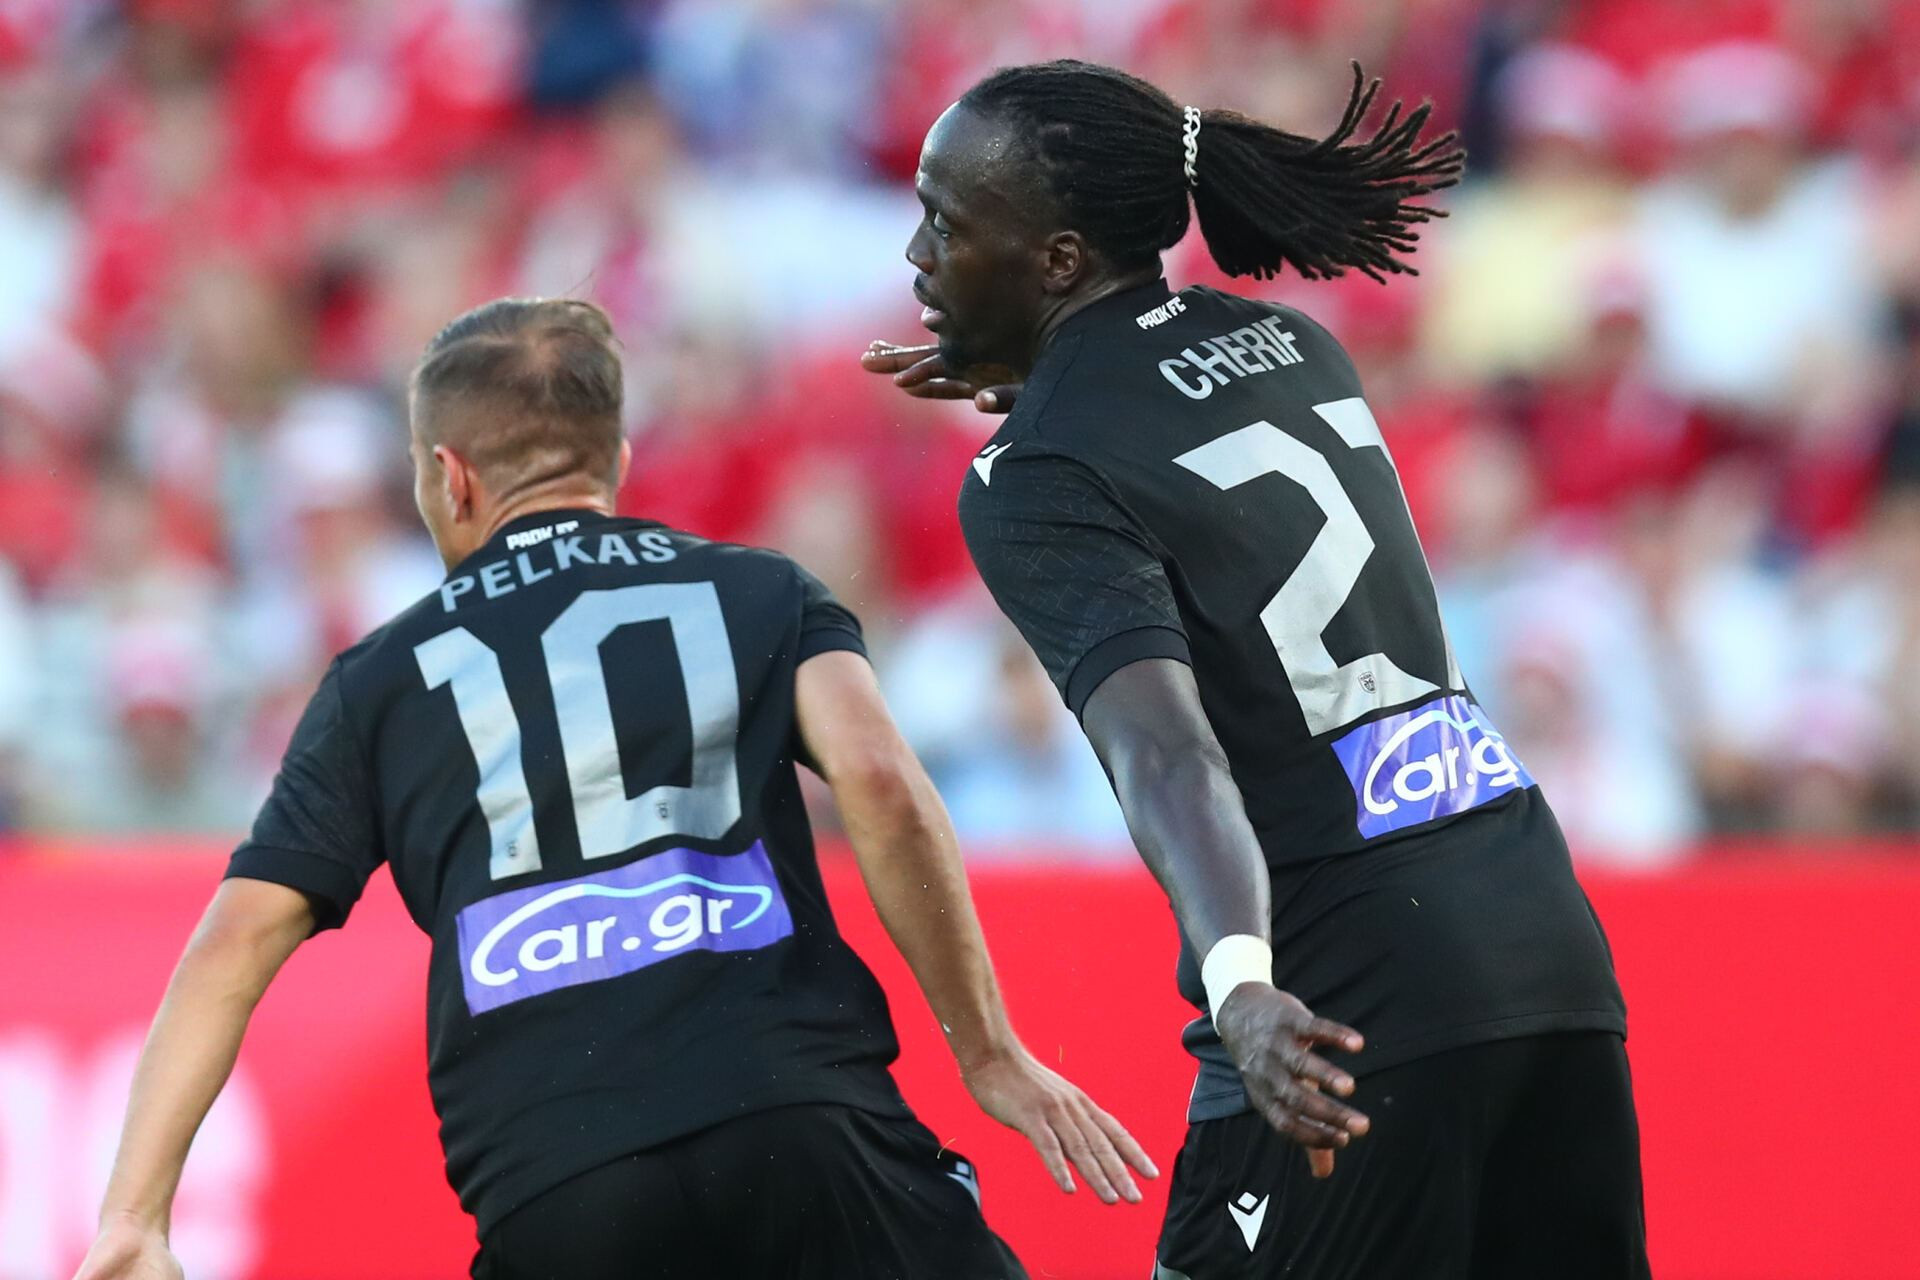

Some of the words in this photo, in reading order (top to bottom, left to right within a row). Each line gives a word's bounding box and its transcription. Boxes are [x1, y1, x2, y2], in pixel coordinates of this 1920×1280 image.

[1136, 305, 1172, 329] PAOK
[1166, 296, 1186, 316] FC
[1158, 315, 1304, 400] CHERIF
[440, 532, 677, 613] PELKAS
[413, 581, 742, 881] 10
